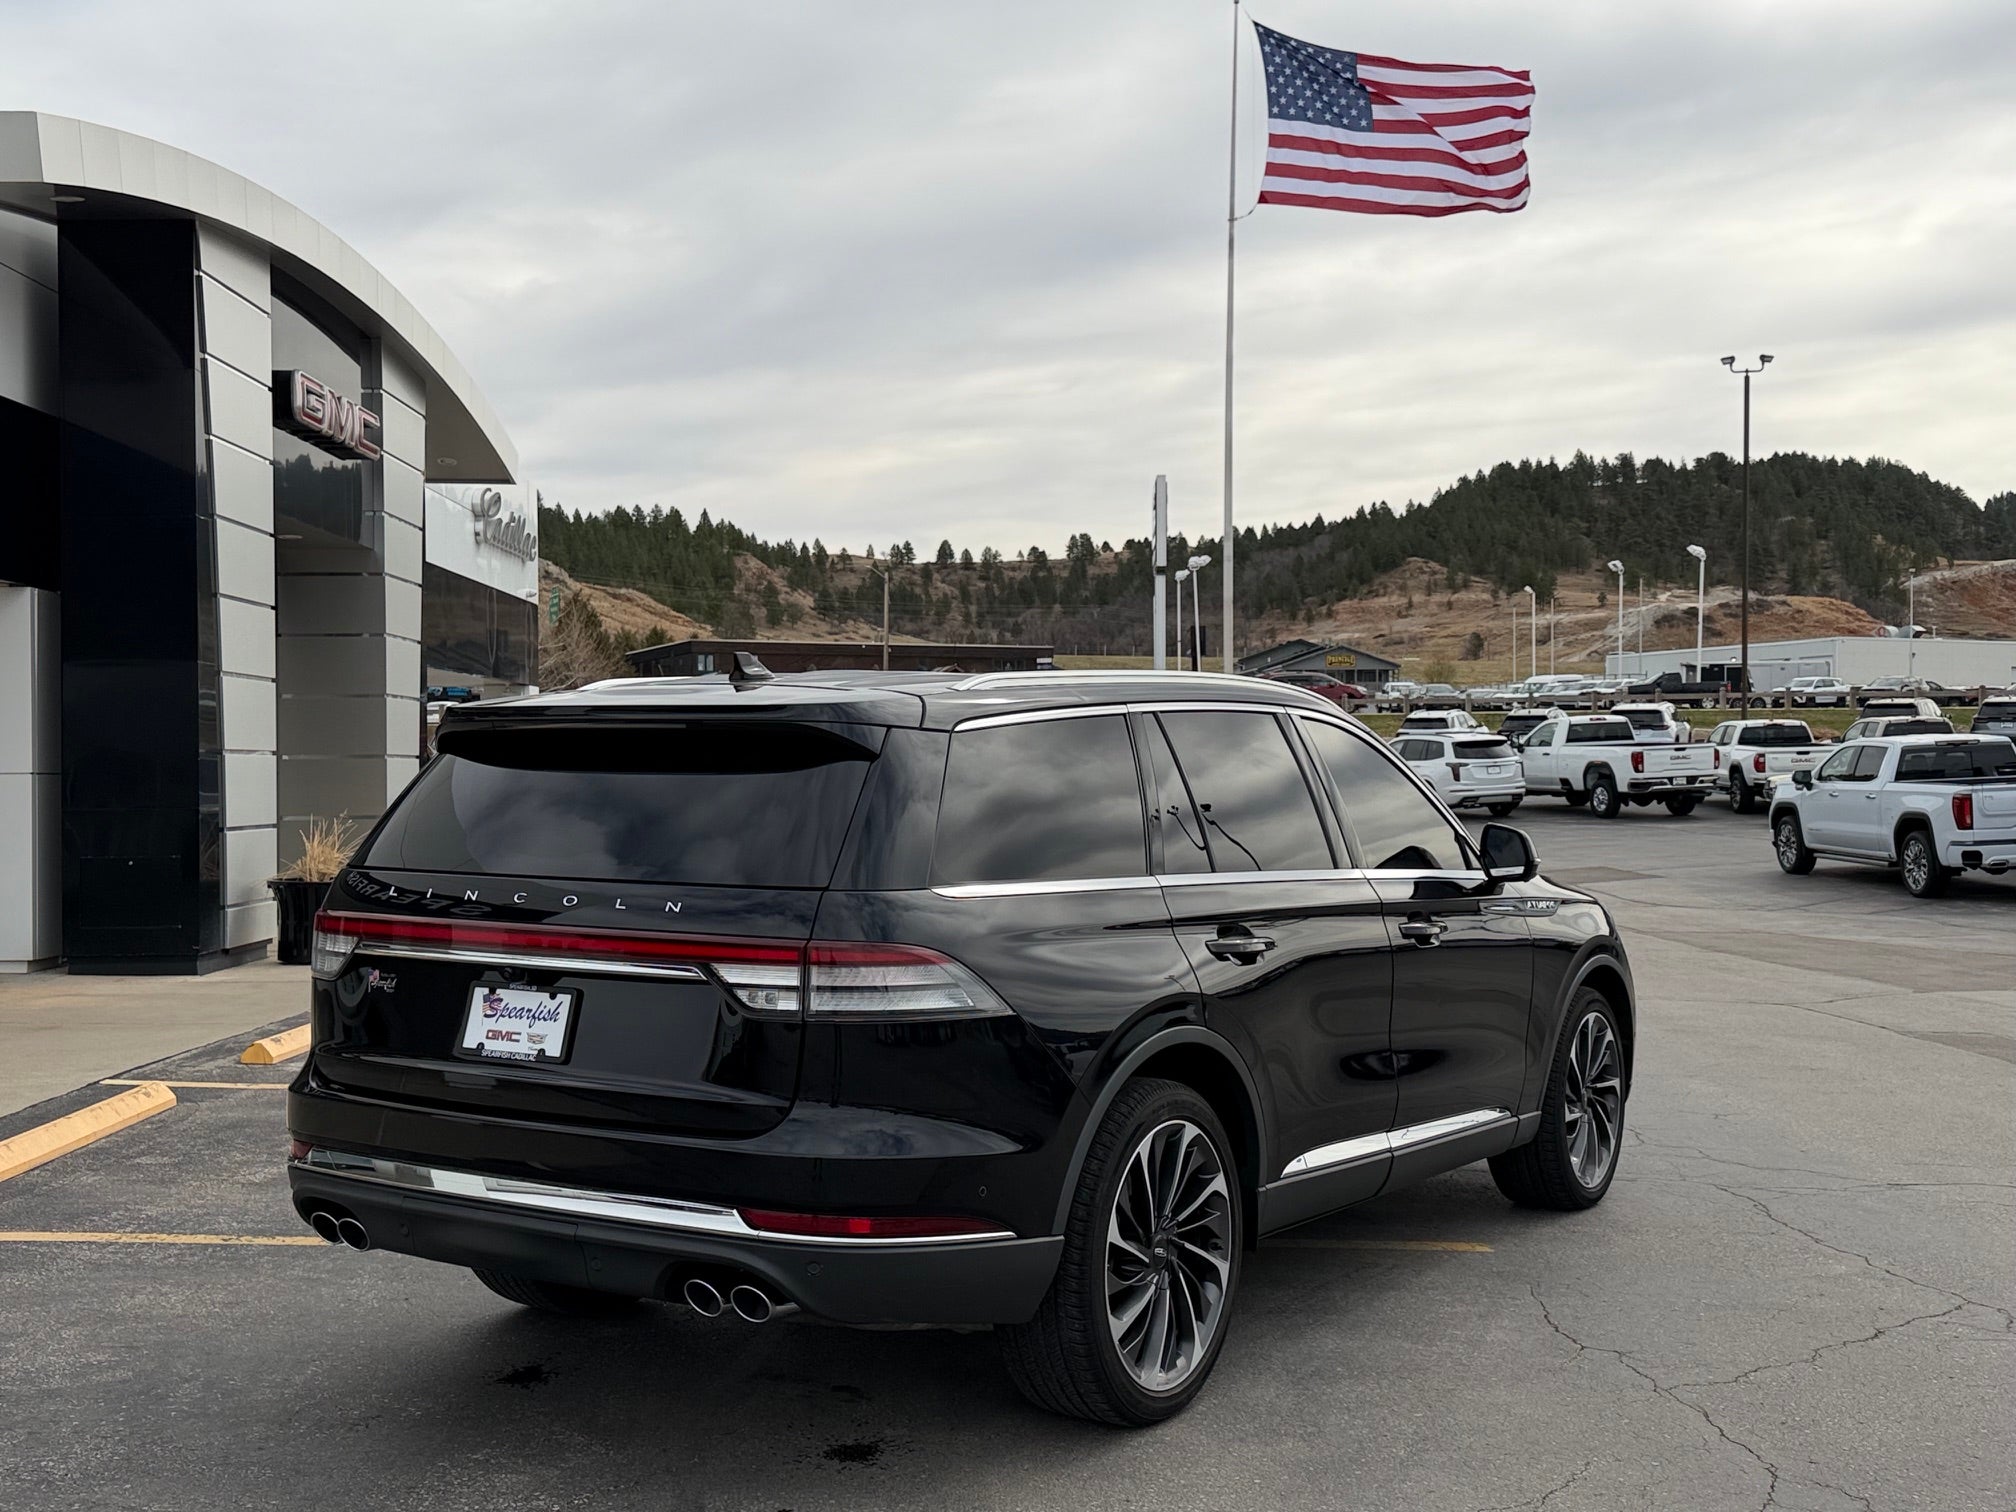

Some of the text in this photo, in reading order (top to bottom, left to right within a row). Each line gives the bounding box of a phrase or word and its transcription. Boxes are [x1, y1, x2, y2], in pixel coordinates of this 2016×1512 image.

[291, 369, 381, 462] GMC
[476, 487, 537, 562] Cadillac
[388, 885, 683, 914] LINCOLN
[483, 998, 563, 1029] Spearfish
[485, 1029, 522, 1043] GMC
